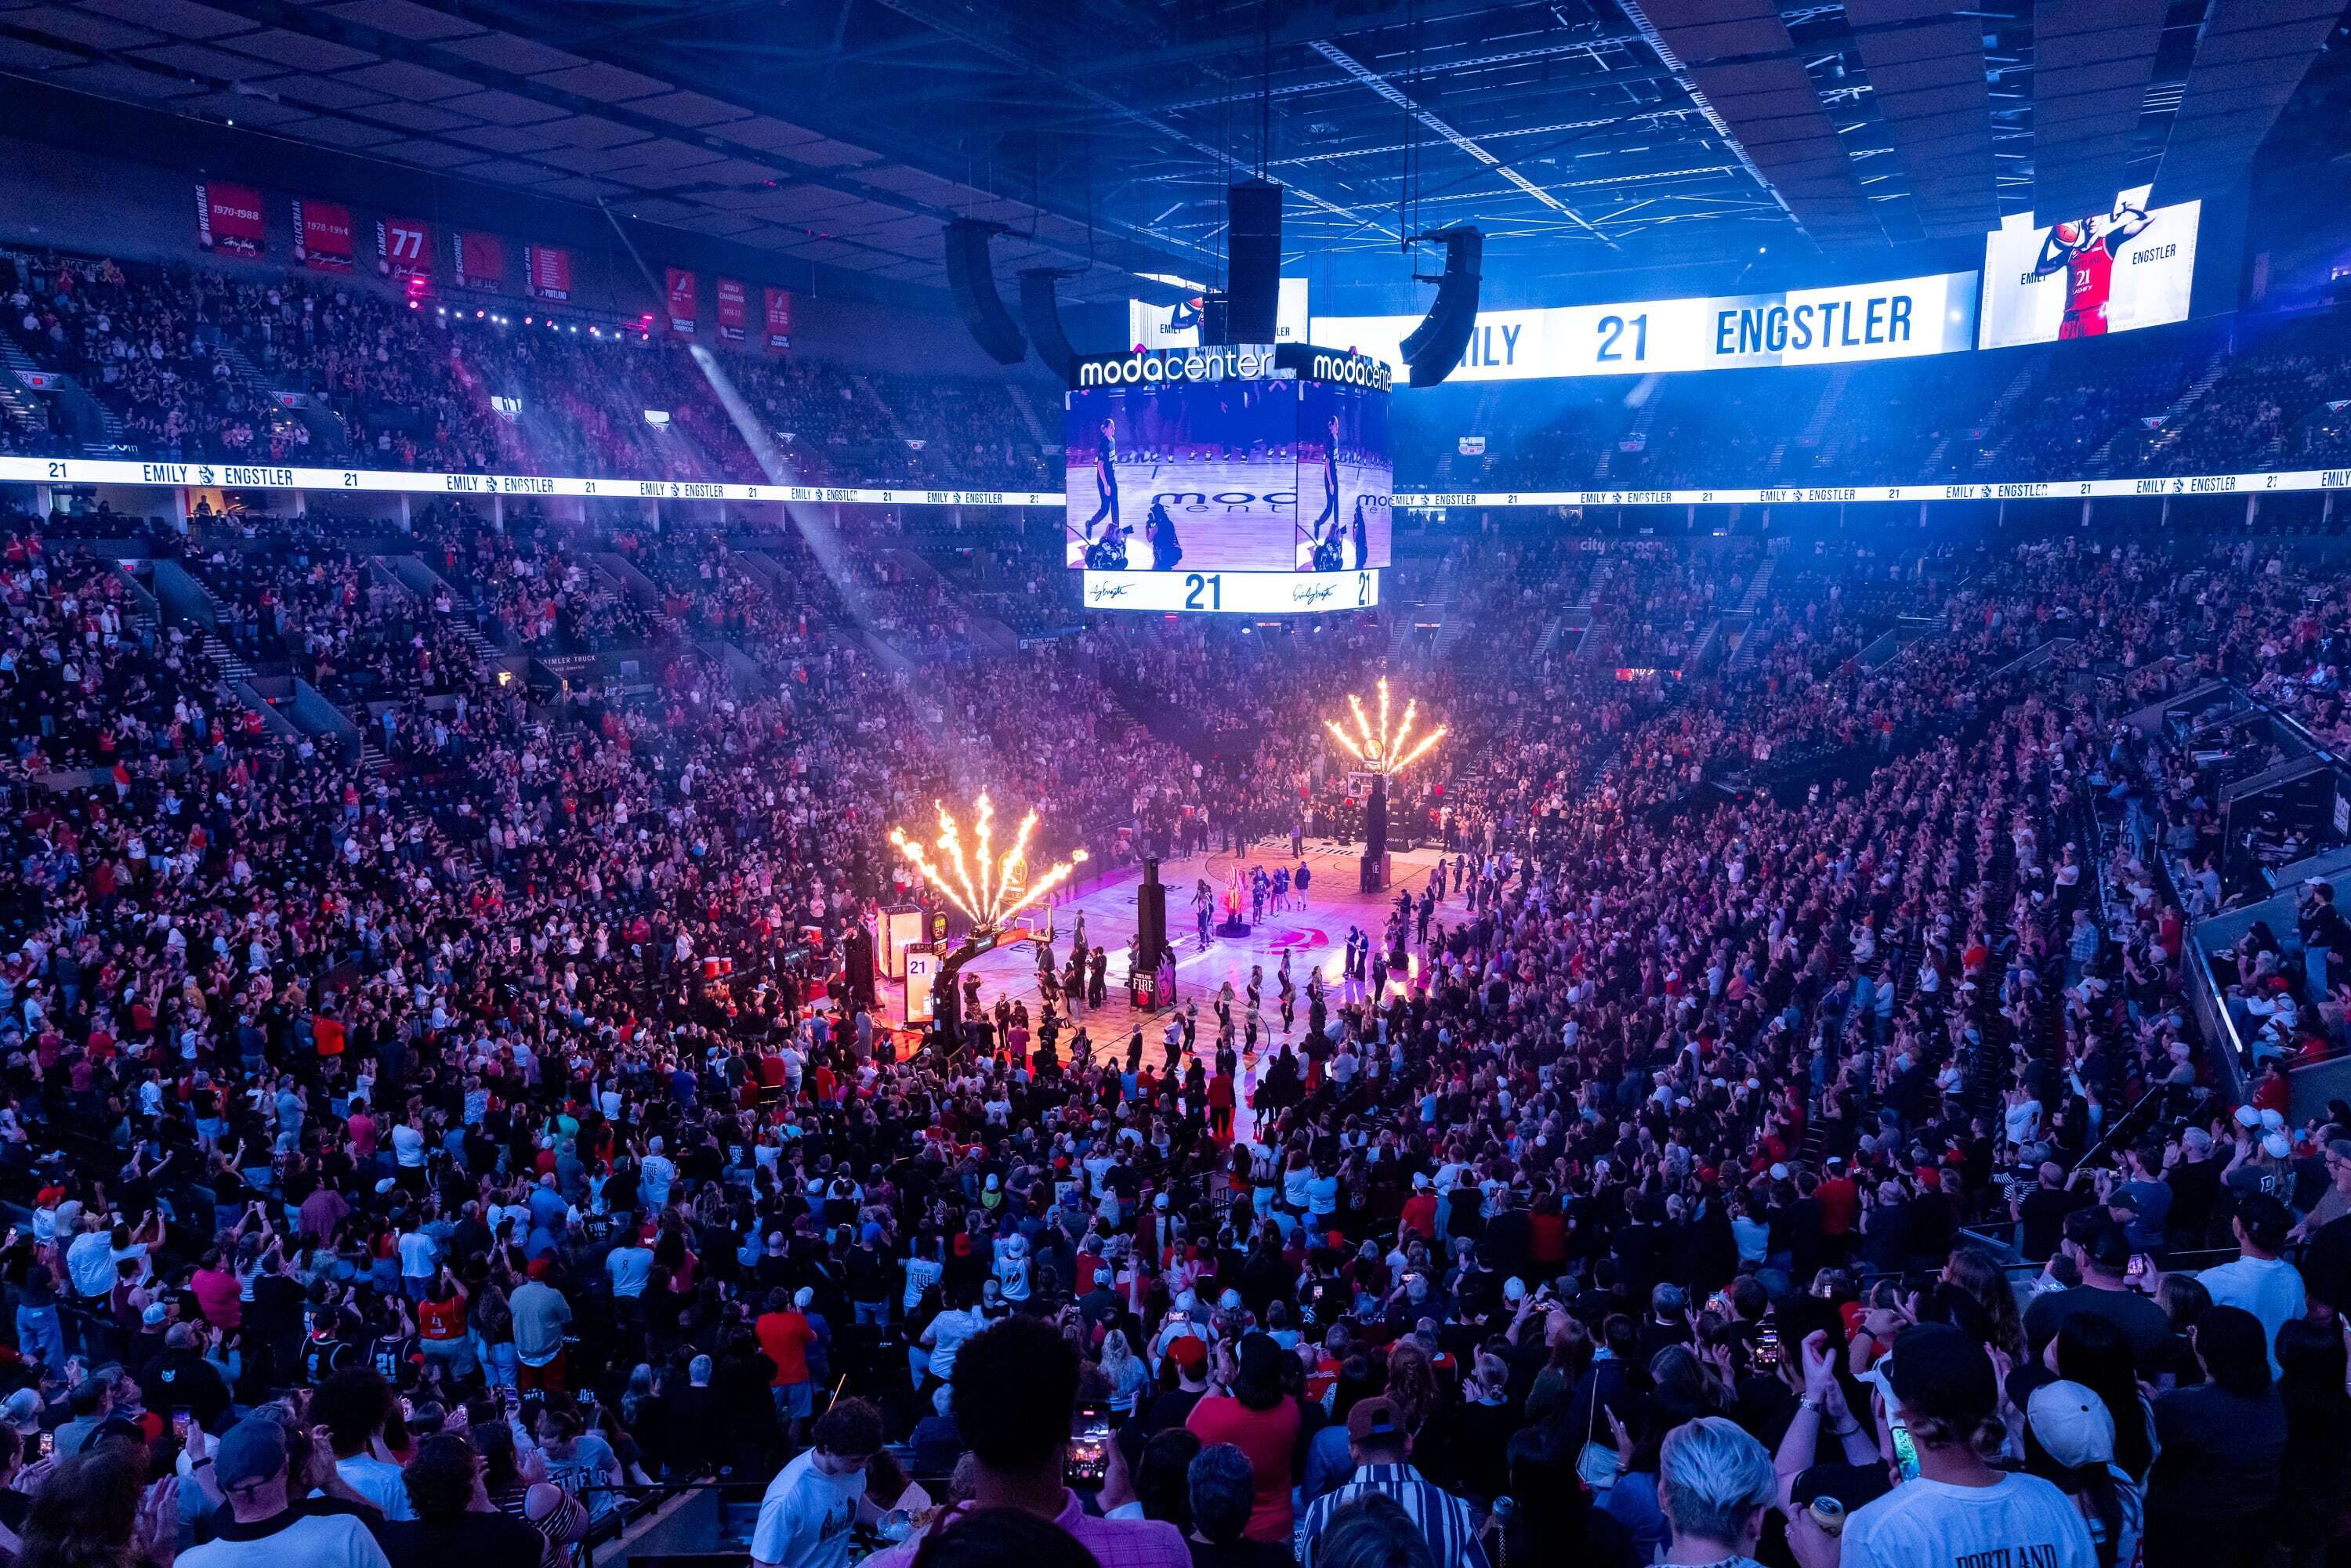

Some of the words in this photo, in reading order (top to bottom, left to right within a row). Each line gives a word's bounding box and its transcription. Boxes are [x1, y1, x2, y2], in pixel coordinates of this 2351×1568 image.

[196, 185, 210, 231] WEINBERG
[214, 205, 259, 220] 1970-1988
[292, 200, 304, 244] GLICKMAN
[376, 220, 387, 256] RAMSAY
[392, 227, 423, 259] 77
[453, 233, 464, 273] SCHONELY
[2132, 244, 2176, 266] ENGSTLER
[2076, 268, 2091, 287] 21
[545, 289, 567, 299] PORTLAND
[719, 292, 744, 302] CHAMPIONS
[1596, 313, 1647, 363] 21
[1715, 295, 1913, 364] ENGSTLER
[1313, 353, 1393, 394] modacente
[49, 462, 66, 477] 21
[143, 465, 187, 483] EMILY
[225, 467, 292, 486] ENGSTLER
[345, 473, 357, 486] 21
[447, 476, 478, 491] EMILY
[505, 478, 553, 492] ENGSTLER
[586, 482, 595, 492] 21
[641, 483, 665, 495] EMILY
[685, 484, 723, 497] ENGSTLER
[749, 487, 756, 497] 21
[792, 488, 810, 499] EMILY
[883, 492, 891, 501] 21
[928, 492, 947, 502] EMILY
[966, 493, 1002, 503] ENGSTLER
[1393, 495, 1415, 505] EMILY
[1436, 495, 1476, 505] ENGSTLER
[1581, 493, 1606, 503] EMILY
[1628, 492, 1671, 502] ENGSTLER
[1760, 491, 1786, 502] EMILY
[1809, 489, 1855, 500] ENGSTLER
[1889, 489, 1899, 498] 21
[1947, 486, 1974, 498] EMILY
[2081, 483, 2091, 494] 21
[2136, 480, 2166, 493] EMILY
[2191, 476, 2235, 491] ENGSTLER
[2321, 471, 2351, 487] EMILY
[1185, 574, 1220, 610] 21
[1358, 571, 1370, 606] 21
[574, 654, 596, 663] TRUCK
[935, 925, 945, 937] 24
[910, 961, 925, 975] 21
[1132, 977, 1154, 992] FIRE
[729, 1148, 744, 1157] FIRE
[643, 1165, 658, 1176] FIRE
[589, 1222, 607, 1233] FIRE
[910, 1273, 933, 1287] FIRE
[432, 1316, 443, 1328] 4
[375, 1353, 397, 1376] 21
